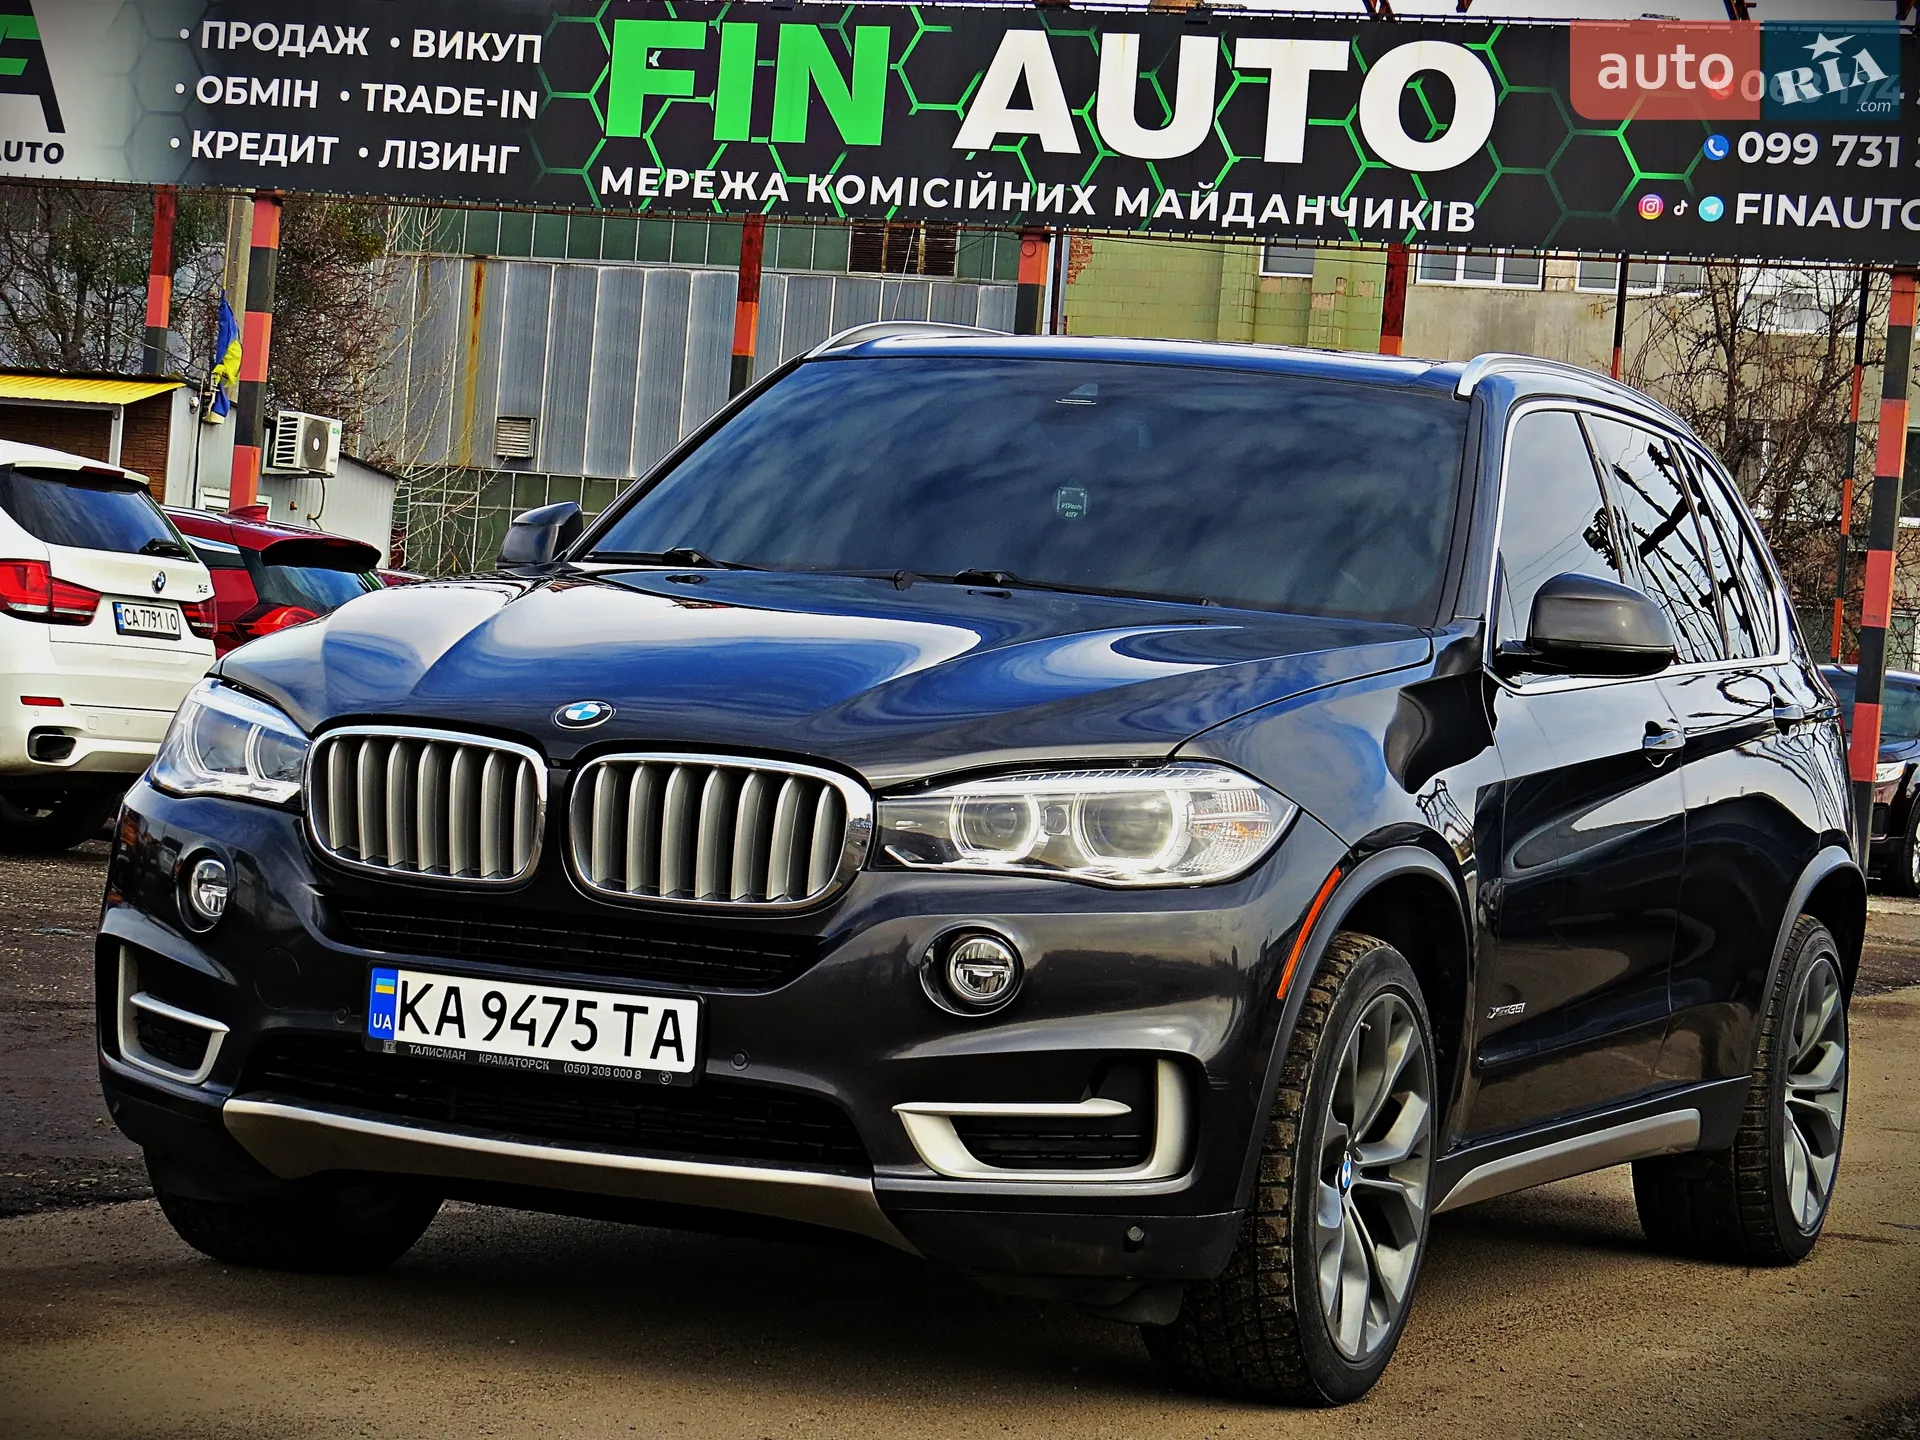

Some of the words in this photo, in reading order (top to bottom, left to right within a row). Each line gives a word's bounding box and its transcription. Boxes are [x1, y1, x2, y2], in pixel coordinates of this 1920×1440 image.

[201, 20, 370, 57] ПРОДАЖ
[412, 29, 543, 64] ВИКУП
[196, 75, 319, 109] ОБМІН
[361, 82, 538, 120] TRADE-IN
[605, 19, 891, 146] FIN
[952, 29, 1496, 172] AUTO
[0, 140, 64, 165] UTO
[191, 130, 340, 168] КРЕДИТ
[379, 139, 520, 175] ЛІЗИНГ
[1737, 131, 1819, 165] 099
[1832, 134, 1900, 168] 731
[600, 165, 789, 203] МЕРЕЖА
[807, 171, 1097, 217] КОМІСІЙНИХ
[1114, 182, 1476, 233] МАЙДАНЧИКІВ
[373, 1013, 393, 1031] UA
[409, 1044, 466, 1061] ТАЛИСМАН
[479, 1053, 550, 1071] КРАМАТОРСК
[563, 1062, 590, 1076] (050)
[592, 1066, 611, 1077] 308
[613, 1068, 633, 1079] 000
[634, 1070, 642, 1080] 8
